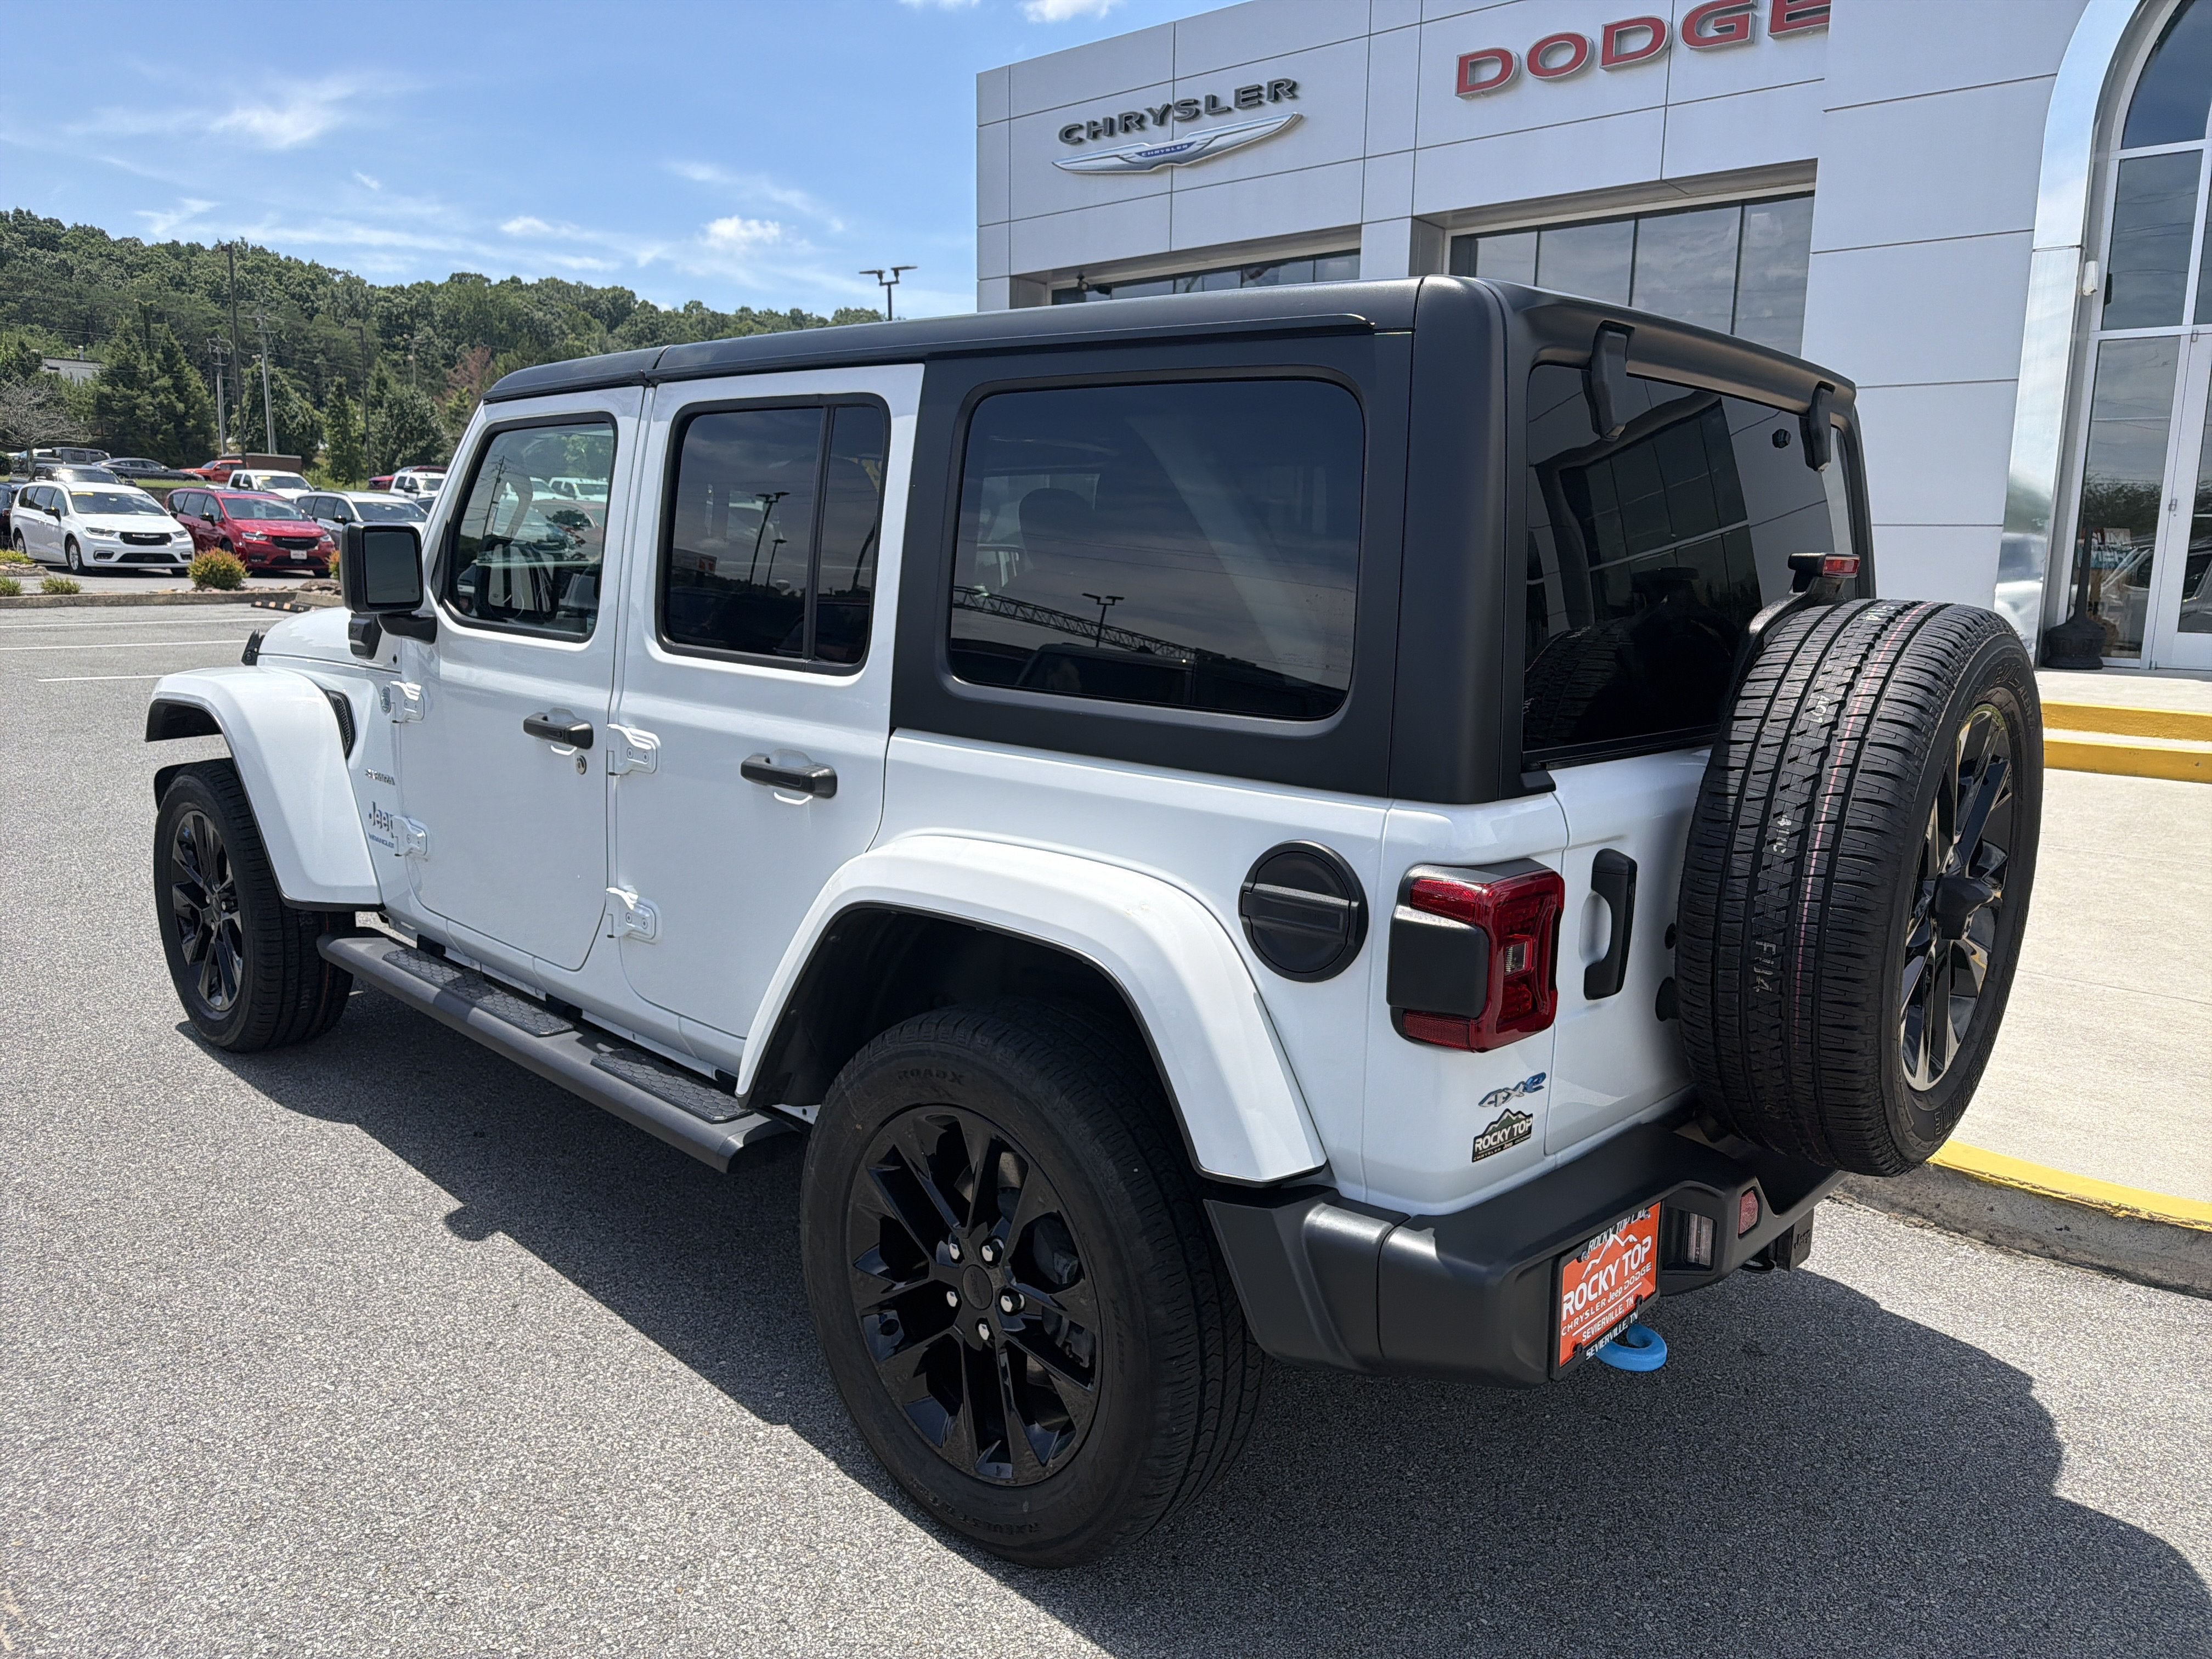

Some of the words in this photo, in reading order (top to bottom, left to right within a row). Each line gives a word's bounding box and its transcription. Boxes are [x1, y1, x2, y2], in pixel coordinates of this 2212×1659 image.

[1455, 0, 1830, 99] DODGE
[1058, 78, 1300, 144] CHRYSLER
[1142, 144, 1188, 156] CHRYSLER
[1475, 1126, 1511, 1152] ROCKY
[1513, 1116, 1533, 1136] TOP
[1588, 1225, 1615, 1254] ROCKY
[1794, 1229, 1810, 1249] Jeep
[1561, 1298, 1607, 1336] CHRYSLER
[1607, 1286, 1623, 1304] Jeep
[1624, 1261, 1652, 1290] DODGE
[1562, 1258, 1620, 1321] ROCKY
[1622, 1235, 1652, 1278] TOP
[1582, 1304, 1625, 1342] SEVIERVILLE,
[1626, 1295, 1634, 1309] TN
[1629, 1310, 1638, 1324] TN
